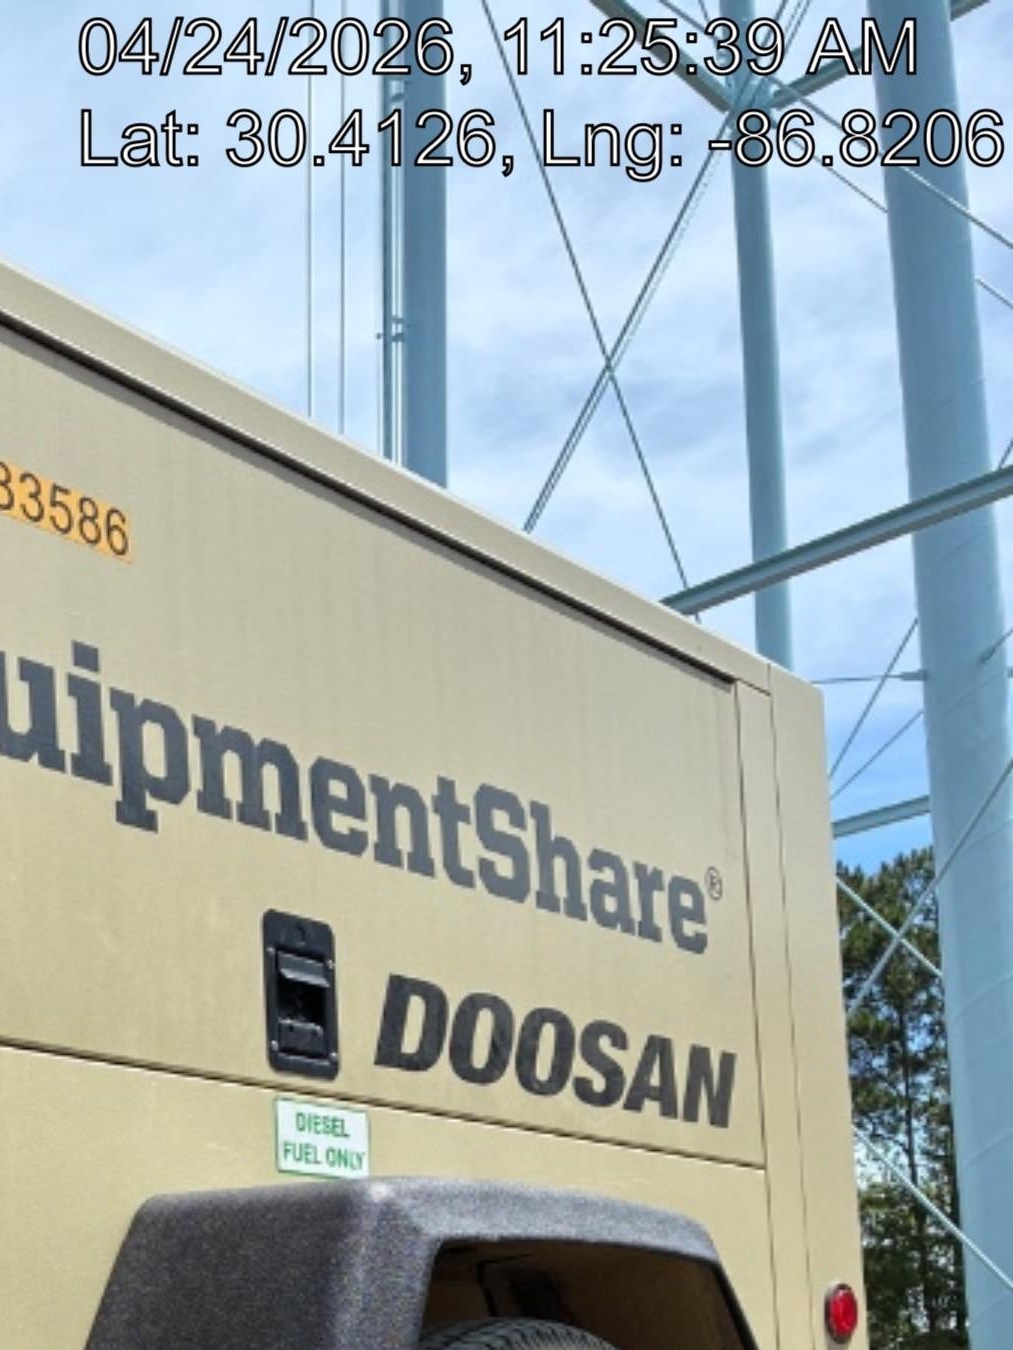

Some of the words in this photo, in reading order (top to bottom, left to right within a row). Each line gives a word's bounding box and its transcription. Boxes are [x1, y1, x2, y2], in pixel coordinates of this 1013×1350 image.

[374, 973, 737, 1129] DOOSAN
[295, 1111, 351, 1139] DIESEL
[282, 1139, 322, 1165] FUEL
[325, 1145, 366, 1171] ONLY
